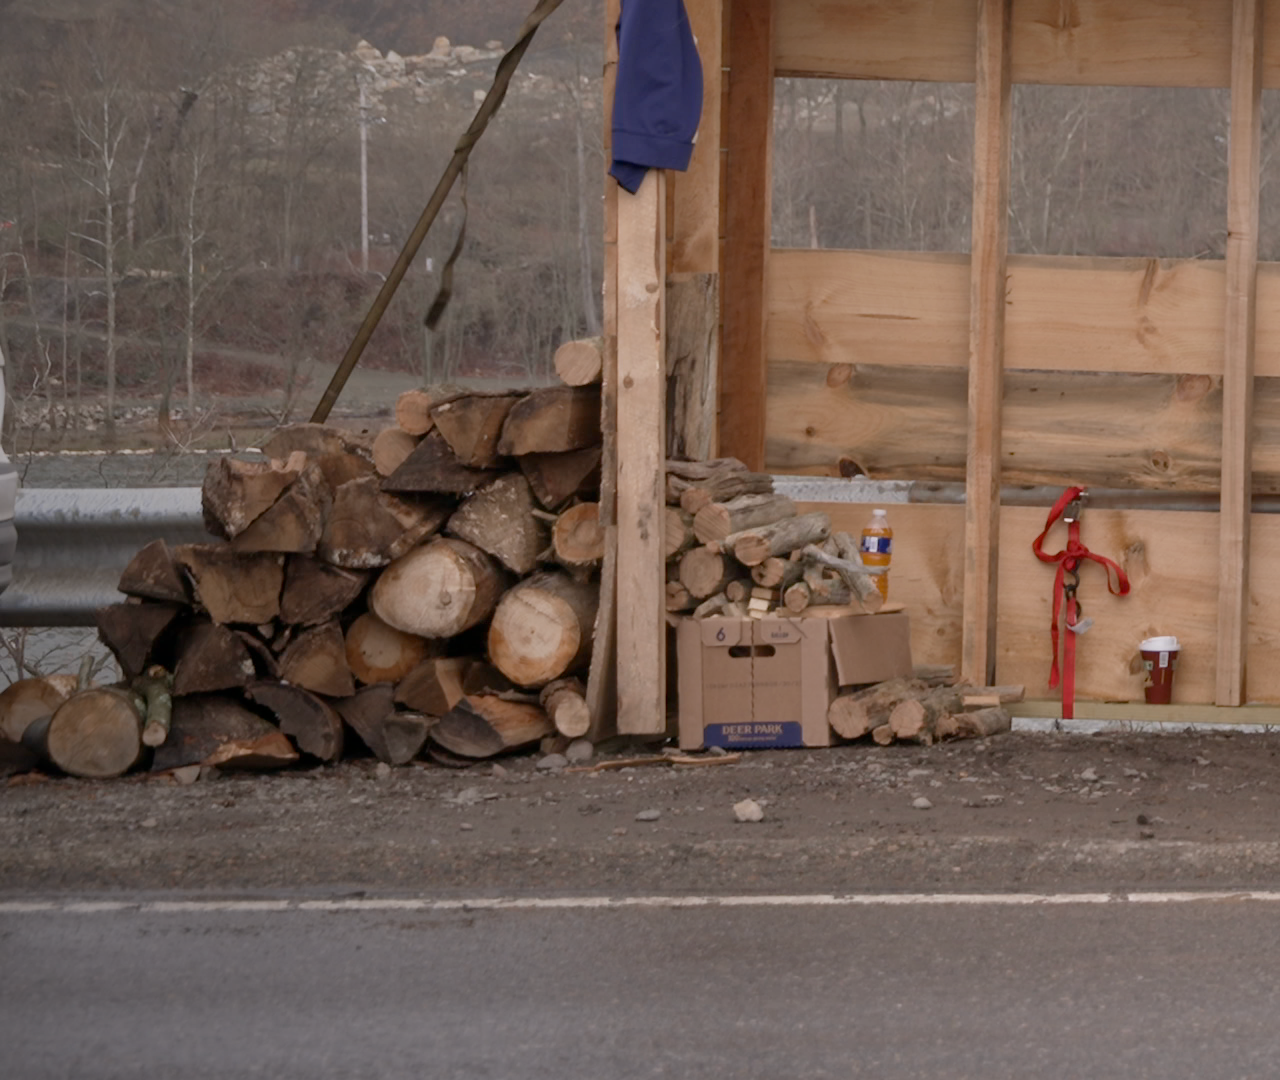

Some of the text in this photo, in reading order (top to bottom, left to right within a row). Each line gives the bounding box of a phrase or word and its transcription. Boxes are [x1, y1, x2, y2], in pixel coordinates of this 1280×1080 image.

[716, 626, 726, 642] 6
[722, 723, 784, 736] DEER PARK
